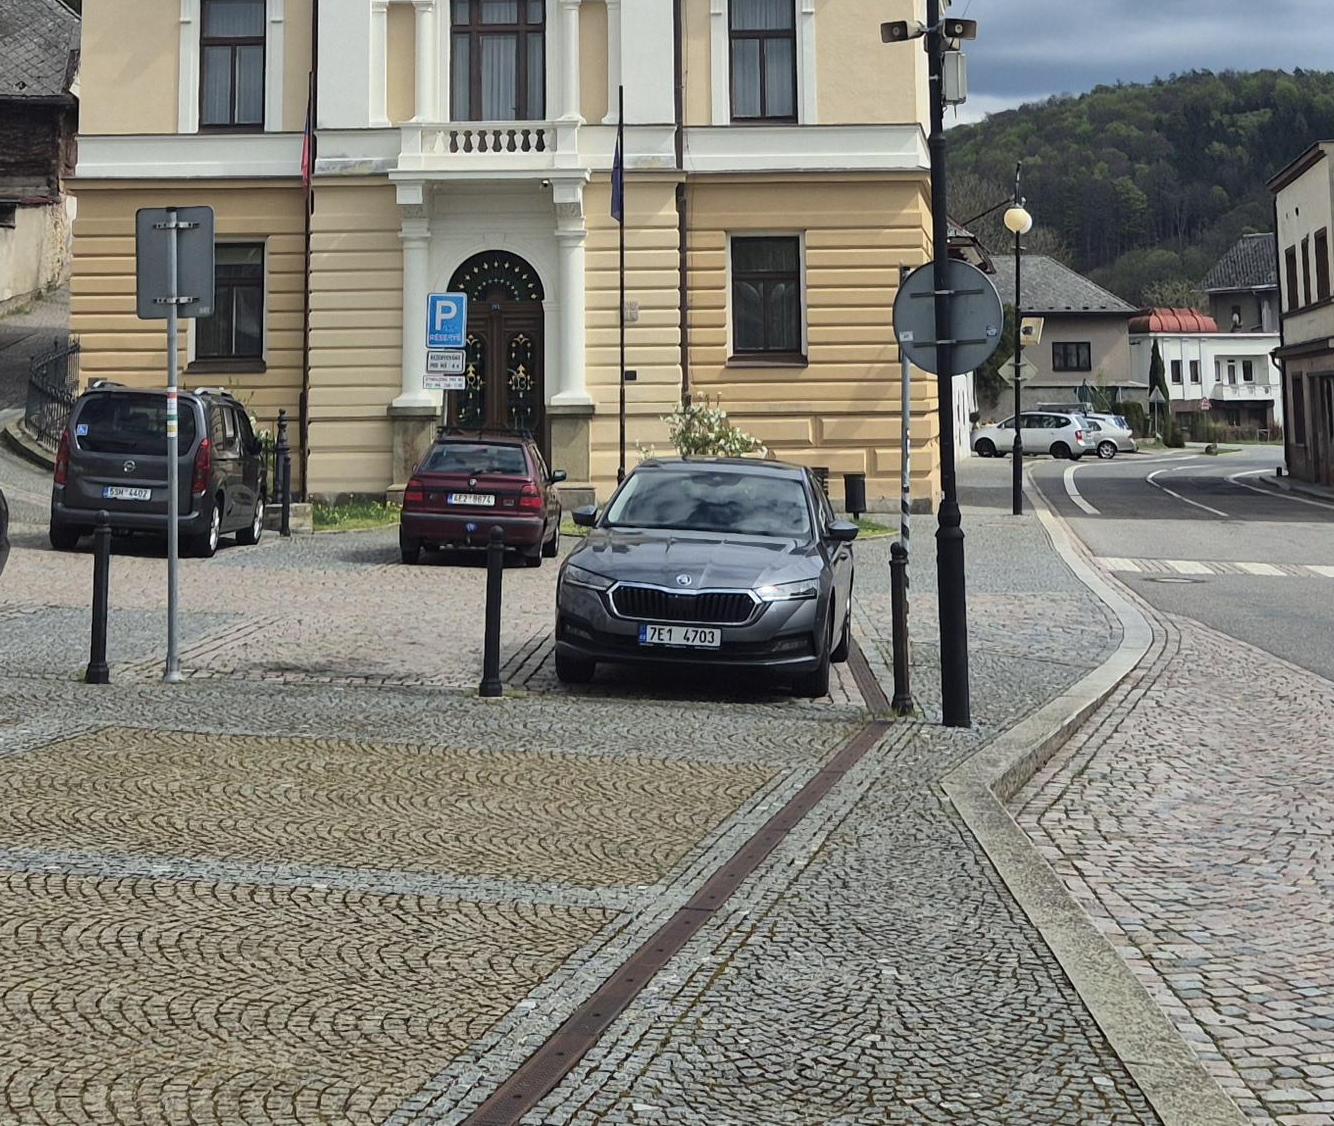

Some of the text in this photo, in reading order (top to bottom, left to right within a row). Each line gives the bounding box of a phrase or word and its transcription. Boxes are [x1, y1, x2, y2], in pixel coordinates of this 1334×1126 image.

[435, 300, 457, 331] P
[650, 627, 715, 644] 7E1 4703
